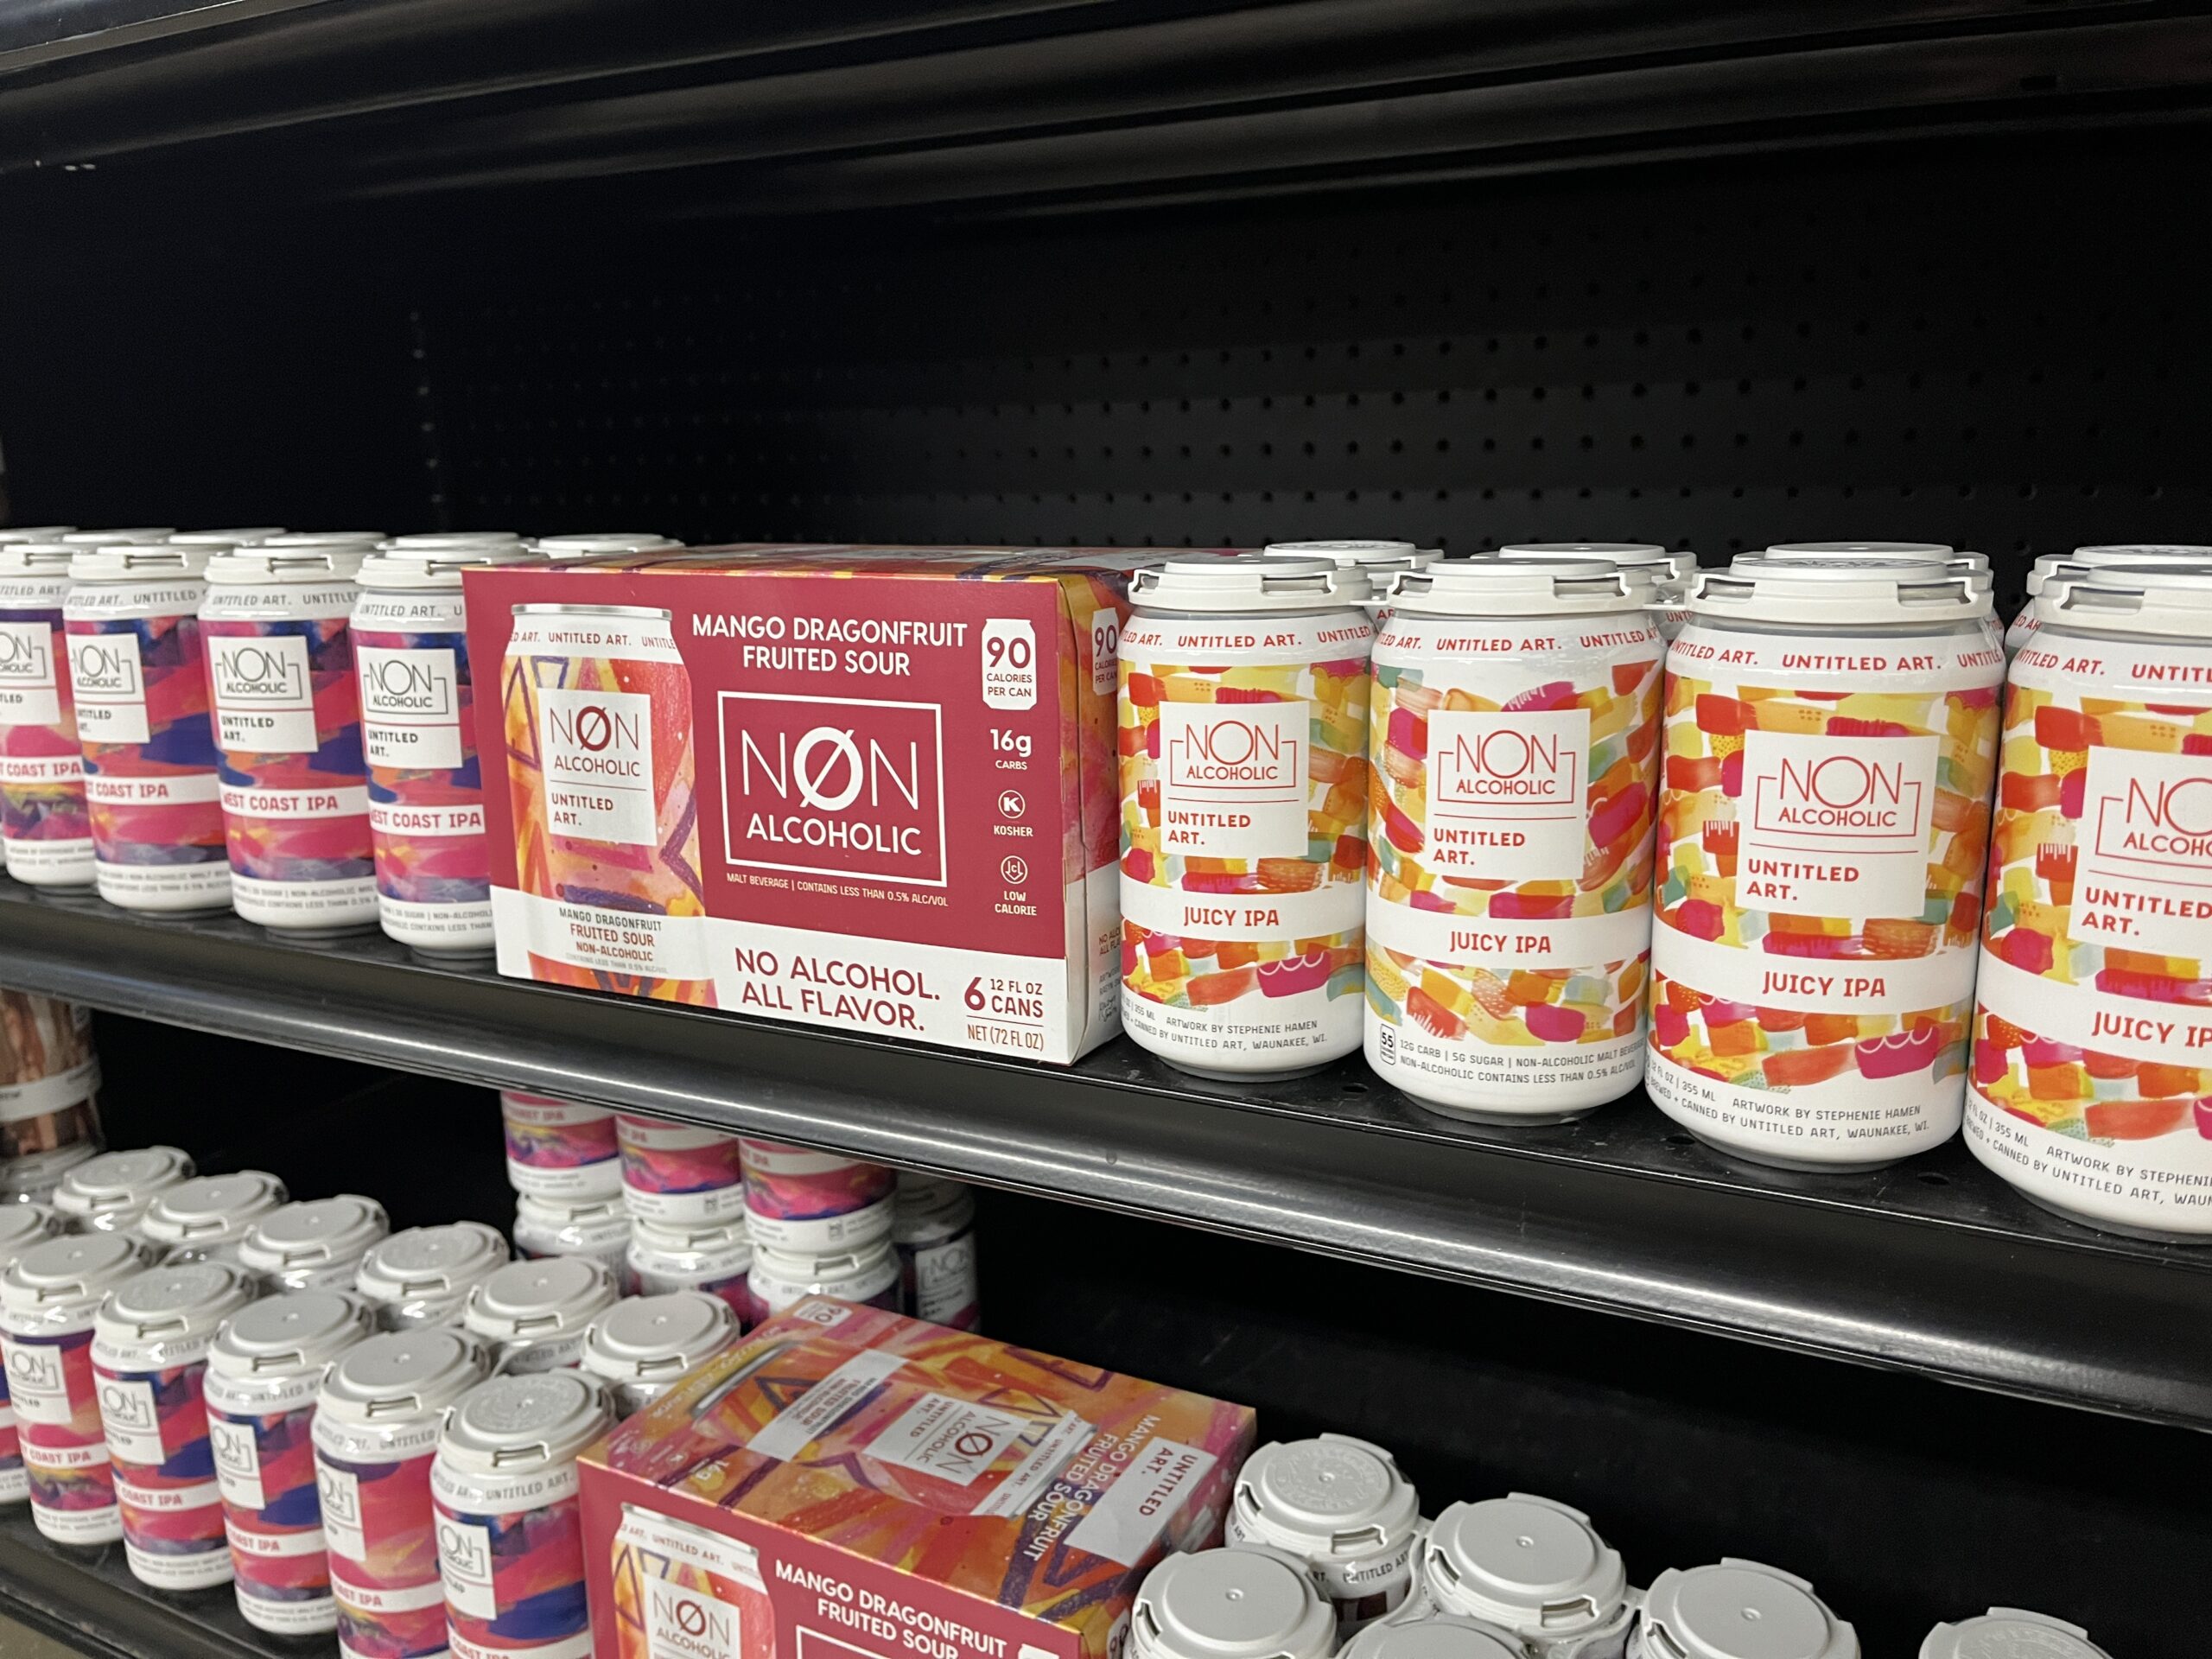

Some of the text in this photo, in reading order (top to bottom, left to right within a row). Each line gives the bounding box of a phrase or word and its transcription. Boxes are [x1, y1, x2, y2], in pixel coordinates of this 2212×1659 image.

[133, 591, 197, 605] UNTITLED
[263, 594, 293, 606] ART.
[410, 606, 442, 617] ART.
[521, 631, 632, 646] ART. UNTITLED ART.
[692, 613, 968, 647] MANGO DRAGONFRUIT
[1094, 624, 1117, 658] 90
[1137, 625, 1371, 649] ART. UNTITLED ART. UNTITLED
[1395, 630, 1645, 652] ART. UNTITLED ART. UNTITLED
[742, 645, 911, 677] FRUITED SOUR
[986, 636, 1032, 670] 90
[1717, 648, 1942, 672] ART. UNTITLED ART.
[221, 647, 286, 683] NON
[2061, 657, 2107, 677] ART.
[226, 682, 288, 694] ALCOHOLIC
[369, 659, 432, 696] NON
[986, 672, 1033, 684] CALORIES
[1095, 673, 1106, 684] PER
[372, 696, 434, 709] ALCOHOLIC
[988, 686, 1033, 698] PER CAN
[221, 715, 275, 728] UNTITLED
[224, 731, 246, 742] ART.
[368, 731, 419, 743] UNTITLED
[989, 728, 1033, 758] 16g
[1185, 720, 1280, 766] NON
[370, 747, 390, 758] ART.
[1456, 728, 1557, 779] NON
[7, 761, 81, 777] COAST IPA
[553, 754, 641, 778] ALCOHOLIC
[995, 760, 1028, 771] CARBS
[1186, 766, 1279, 780] ALCOHOLIC
[95, 783, 168, 798] COAST IPA
[1455, 779, 1556, 796] ALCOHOLIC
[1779, 755, 1904, 810] NON
[249, 795, 339, 811] COAST IPA
[551, 792, 614, 811] UNTITLED
[392, 812, 482, 829] COAST IPA
[554, 811, 582, 827] ART.
[1167, 810, 1252, 829] UNTITLED
[1777, 807, 1898, 828] ALCOHOLIC
[746, 812, 923, 856] ALCOHOLIC
[994, 824, 1034, 838] KOSHER
[1167, 829, 1206, 846] ART.
[1433, 827, 1527, 848] UNTITLED
[1433, 848, 1476, 866] ART.
[1747, 857, 1860, 883] UNTITLED
[726, 872, 950, 907] MALT BEVERAGE CONTAINS LESS THAN 0.5% ALC/VOL
[1003, 890, 1027, 903] LOW
[1746, 880, 1799, 901] ART.
[559, 906, 662, 931] MANGO DRAGONFRUIT
[994, 903, 1038, 917] CALORIE
[1183, 905, 1280, 928] JUICY IPA
[569, 923, 656, 948] FRUITED SOUR
[2081, 911, 2140, 937] ART.
[575, 941, 654, 962] NON-ALCOHOLIC
[1448, 931, 1552, 954] JUICY IPA
[734, 946, 941, 1001] NO ALCOHOL.
[1762, 970, 1886, 998] JUICY IPA
[963, 976, 1044, 1012] 6 12 FL OZ
[741, 980, 925, 1033] ALL FLAVOR.
[991, 995, 1044, 1019] CANS
[1166, 1016, 1319, 1035] ARTWORK BY STEPHENIE HAMEN
[2090, 1010, 2177, 1045] JUICY
[967, 1023, 1045, 1052] NET (72 FL OZ)
[1159, 1029, 1310, 1052] BY UNTITLED ART, WAUNAKEE,
[1381, 1031, 1395, 1049] 55
[1399, 1039, 1619, 1068] 12G CARB 5G SUGAR NON-ALCOHOLIC MALT
[1399, 1054, 1475, 1080] NON-ALCOHOLIC
[1478, 1071, 1530, 1084] CONTAINS
[1533, 1073, 1557, 1084] LESS
[1560, 1071, 1585, 1083] THAN
[1586, 1068, 1609, 1080] 0.5%
[1664, 1071, 1923, 1122] OZ 355 ML ARTWORK BY STEPHENIE HAMEN
[1681, 1096, 1930, 1141] CANNED BY UNTITLED ART, WAUNAKEE, WI.
[1993, 1121, 2012, 1139] 355
[2013, 1130, 2030, 1147] ML
[2046, 1145, 2111, 1173] ARTWORK
[2116, 1164, 2135, 1179] BY
[1992, 1139, 2165, 1205] CANNED BY UNTITLED ART,
[915, 1397, 940, 1415] ART.
[910, 1401, 954, 1438] UNTITLED
[916, 1410, 977, 1464] ALCOHOLIC
[67, 1451, 91, 1463] IPA
[1141, 1446, 1173, 1475] ART.
[486, 1471, 576, 1501] UNTITLED ART.
[1021, 1414, 1161, 1562] MANGO DRAGONFRUIT
[1027, 1432, 1119, 1522] FRUITED SOUR
[1138, 1452, 1199, 1516] UNTITLED
[158, 1493, 183, 1507] IPA
[258, 1538, 280, 1552] IPA
[652, 1533, 726, 1566] UNTITLED ART.
[359, 1591, 383, 1606] IPA
[774, 1559, 1008, 1659] MANGO DRAGONFRUIT
[817, 1597, 898, 1642] FRUITED
